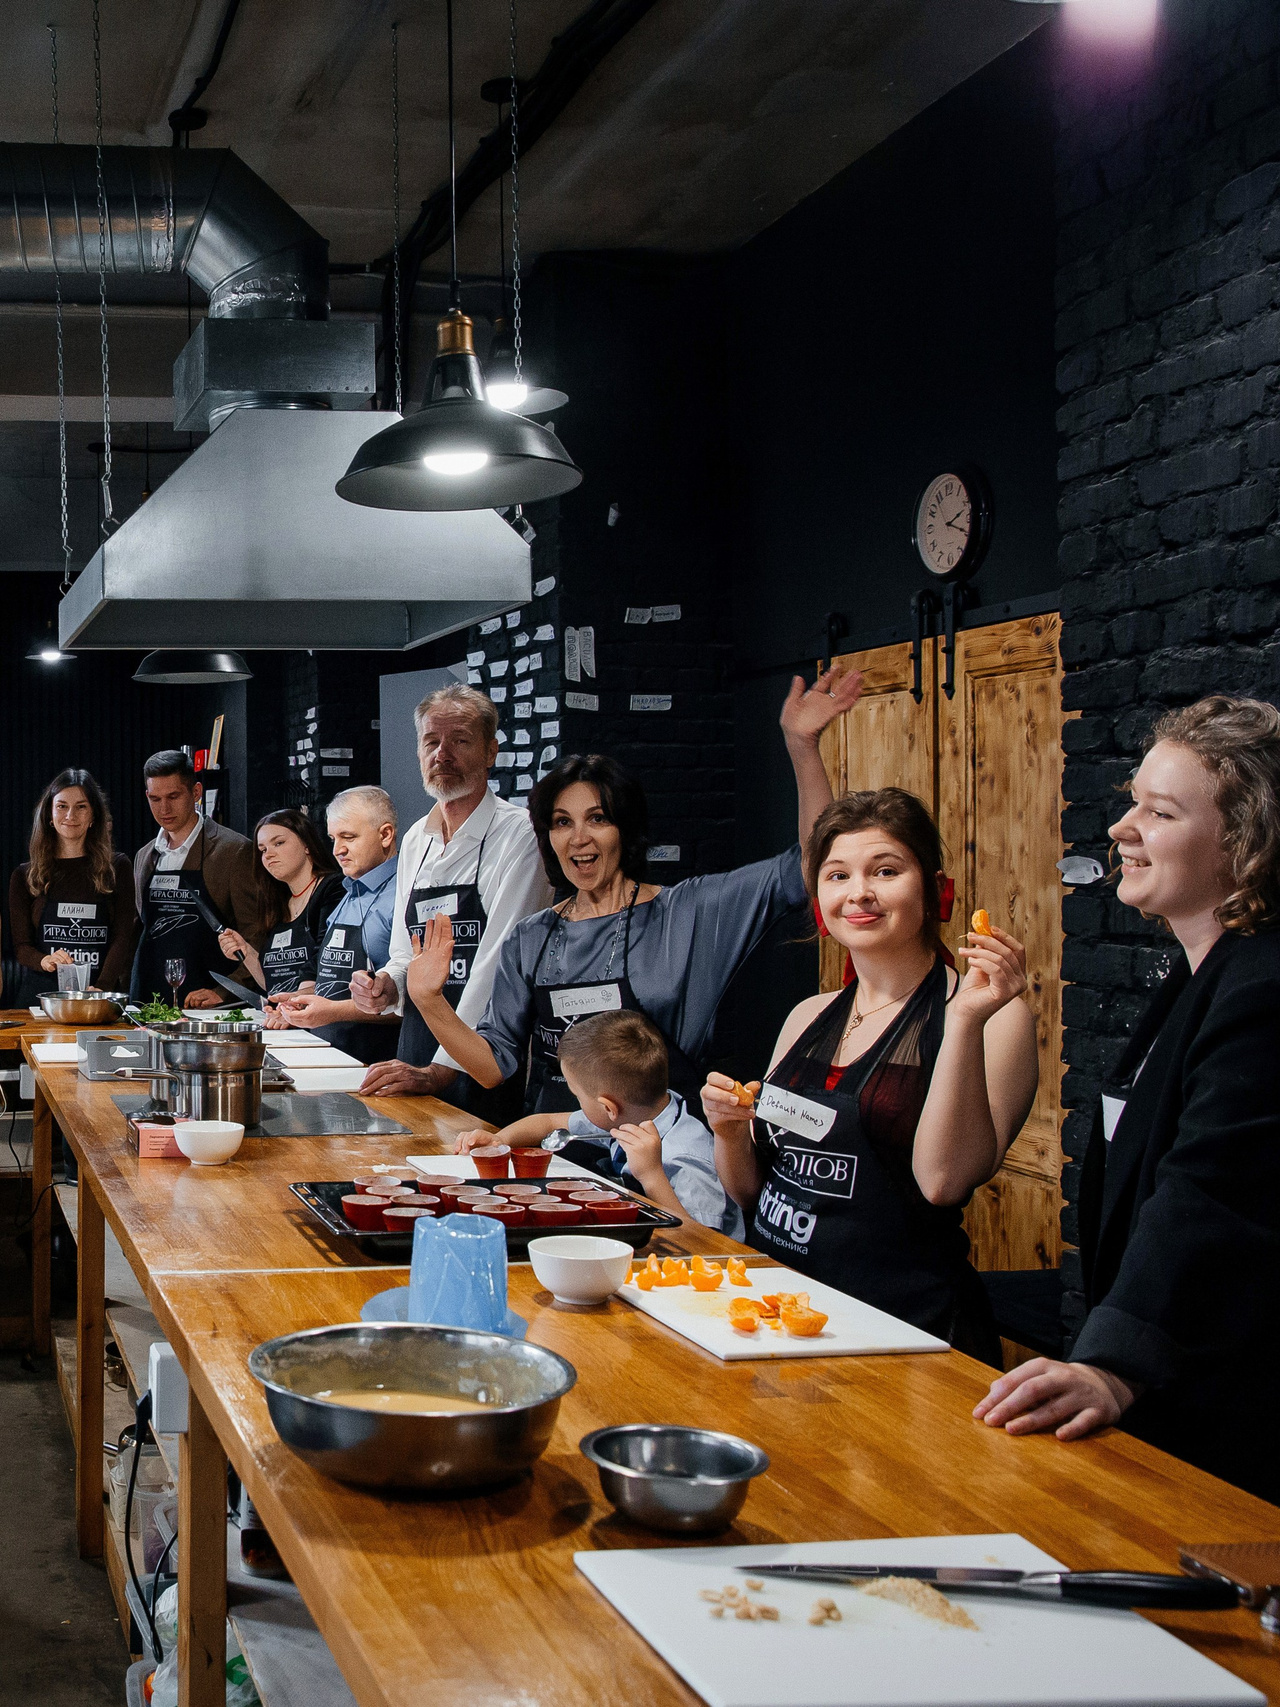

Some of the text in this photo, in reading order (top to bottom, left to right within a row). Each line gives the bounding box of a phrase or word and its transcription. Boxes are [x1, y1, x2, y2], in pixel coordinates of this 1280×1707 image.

[166, 890, 193, 899] СТОЛО
[61, 906, 85, 915] АЛИНА
[558, 996, 596, 1009] Татьяна
[772, 1234, 809, 1255] техника
